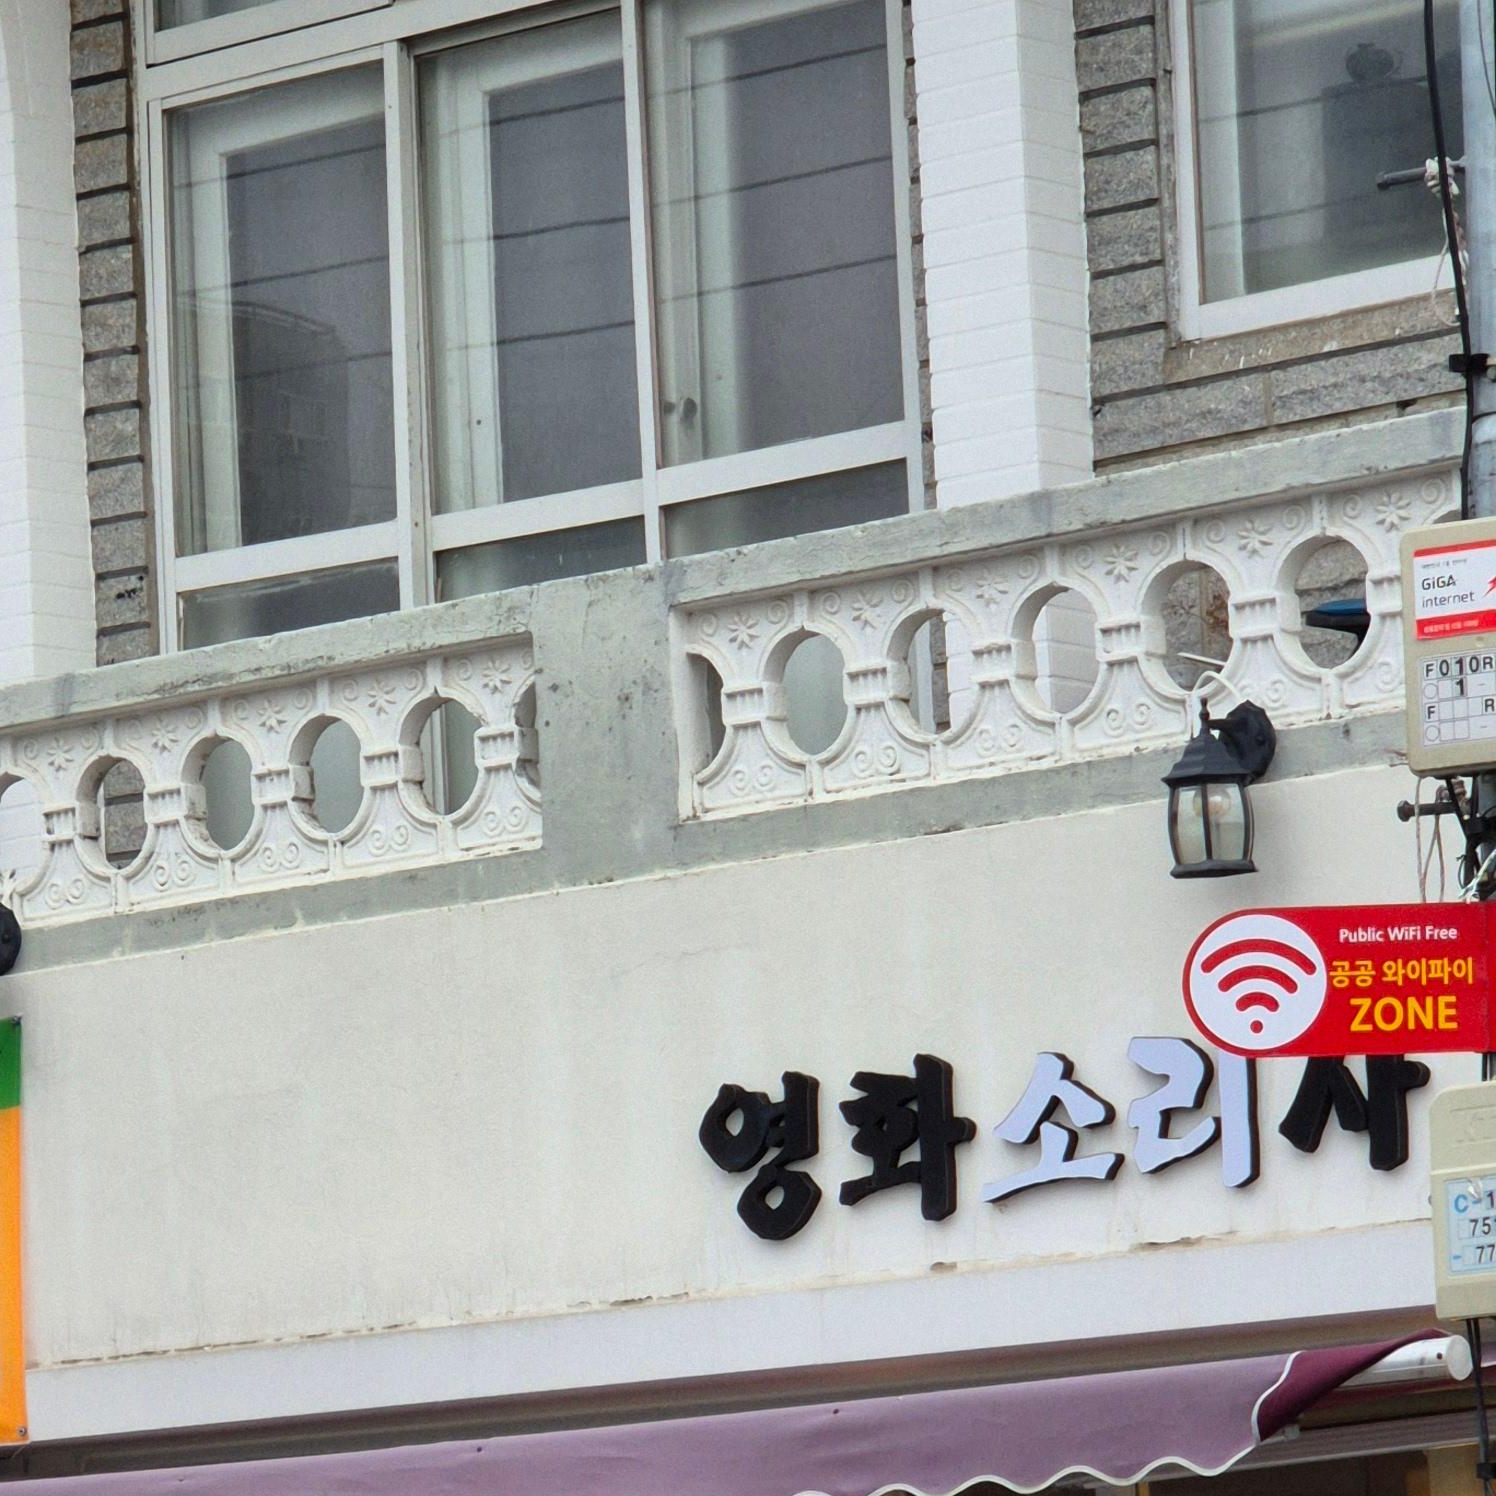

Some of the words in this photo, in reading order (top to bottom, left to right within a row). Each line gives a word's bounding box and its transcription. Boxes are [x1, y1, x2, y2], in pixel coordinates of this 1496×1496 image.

[1421, 574, 1456, 591] GiGA
[1422, 590, 1475, 608] internet
[1339, 927, 1384, 943] Public
[1388, 926, 1422, 941] WiFi
[1425, 925, 1458, 940] Free
[1329, 960, 1376, 987] 공공
[1382, 956, 1475, 986] 와이파이
[1350, 996, 1459, 1032] ZONE
